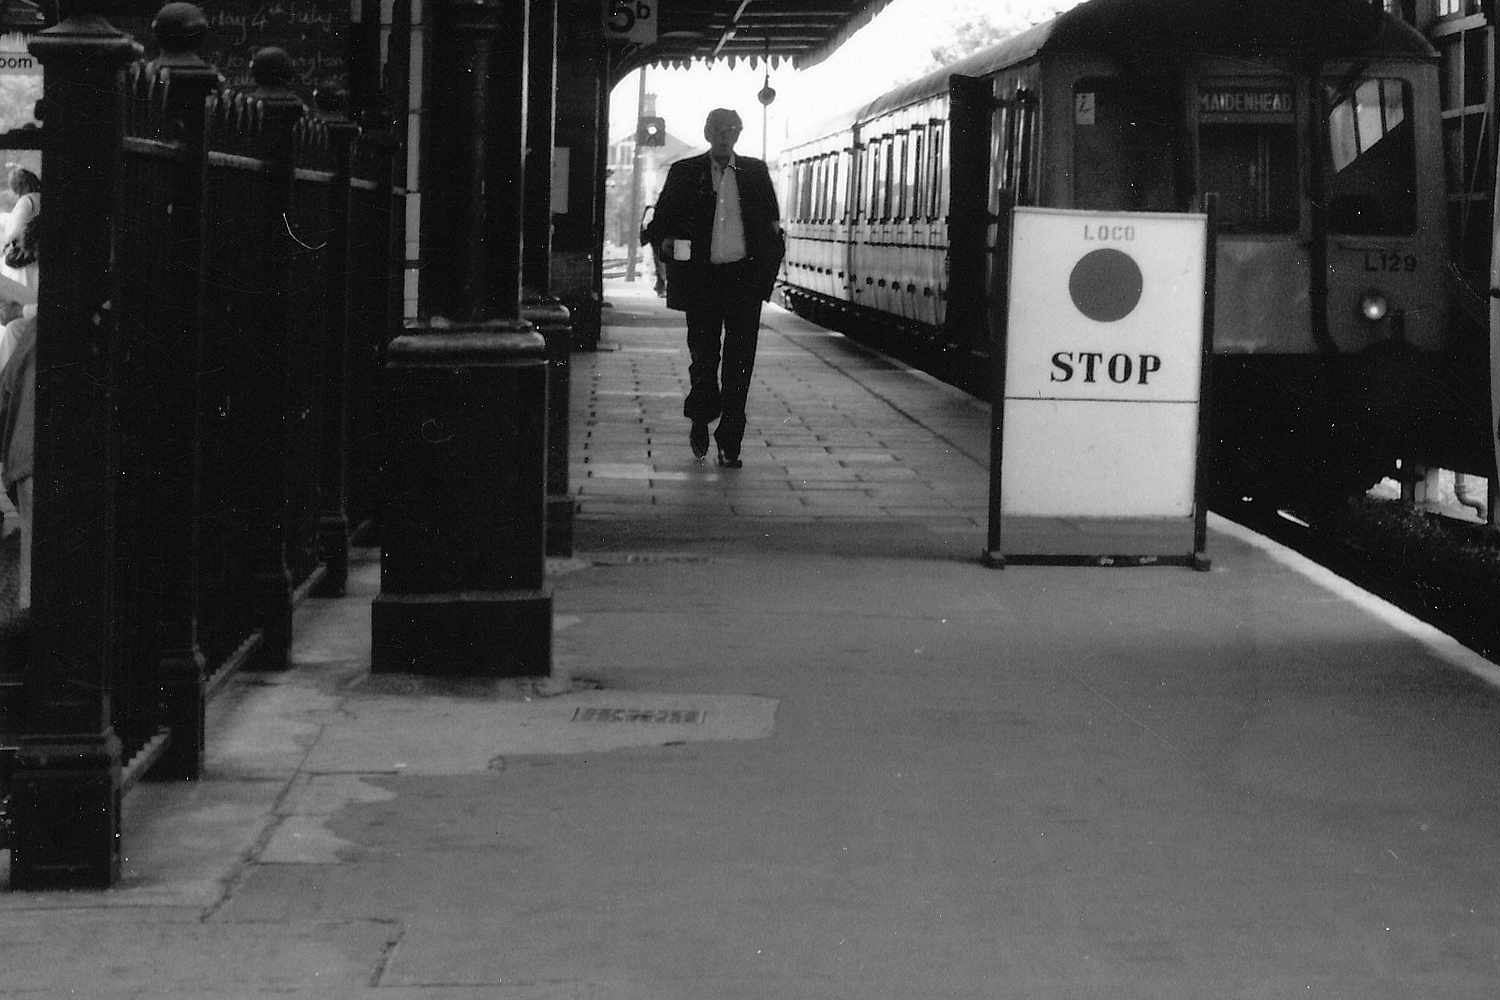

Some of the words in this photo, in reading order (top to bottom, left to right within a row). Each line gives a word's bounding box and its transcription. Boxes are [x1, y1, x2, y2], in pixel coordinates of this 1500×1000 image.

[1198, 92, 1292, 112] MAIDENHEAD
[1083, 223, 1136, 242] LOCO
[1365, 253, 1418, 272] L129
[1050, 351, 1163, 386] STOP
